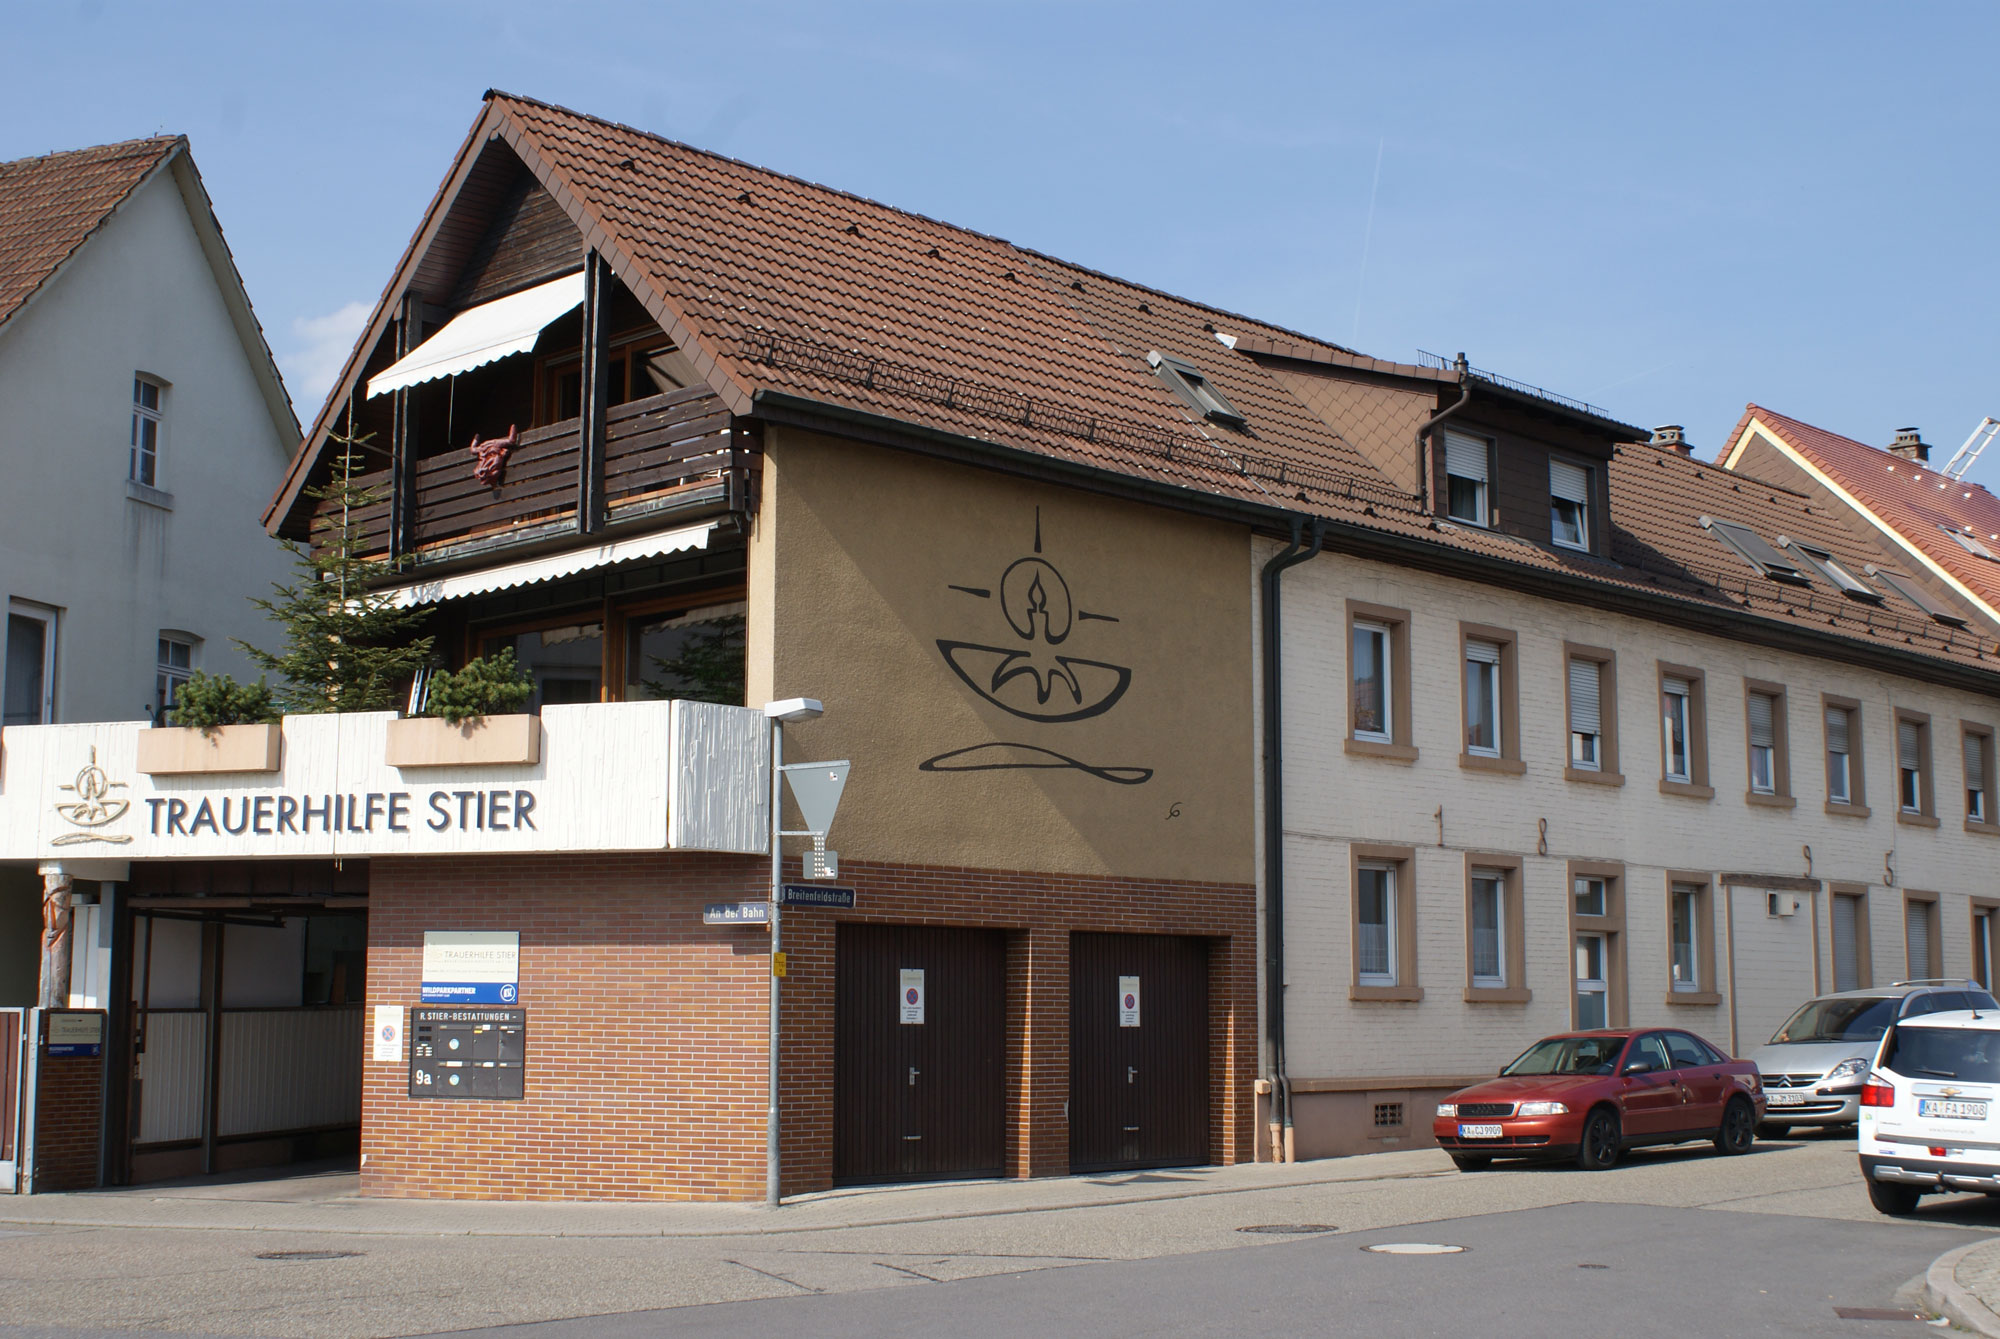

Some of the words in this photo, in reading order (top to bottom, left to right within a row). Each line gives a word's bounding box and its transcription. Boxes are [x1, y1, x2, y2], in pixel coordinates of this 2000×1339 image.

[145, 792, 411, 836] TRAUERHILFE
[426, 790, 538, 831] STIER
[788, 888, 851, 903] Breitenfeldstraße
[710, 908, 721, 919] An
[725, 906, 739, 918] der
[742, 906, 764, 918] Bahn
[444, 951, 494, 959] TRAUERHILFE
[497, 951, 517, 959] STIER
[416, 1069, 432, 1085] 9a
[1925, 1101, 1938, 1113] KA
[1945, 1102, 1957, 1114] FA
[1960, 1104, 1986, 1116] 1908
